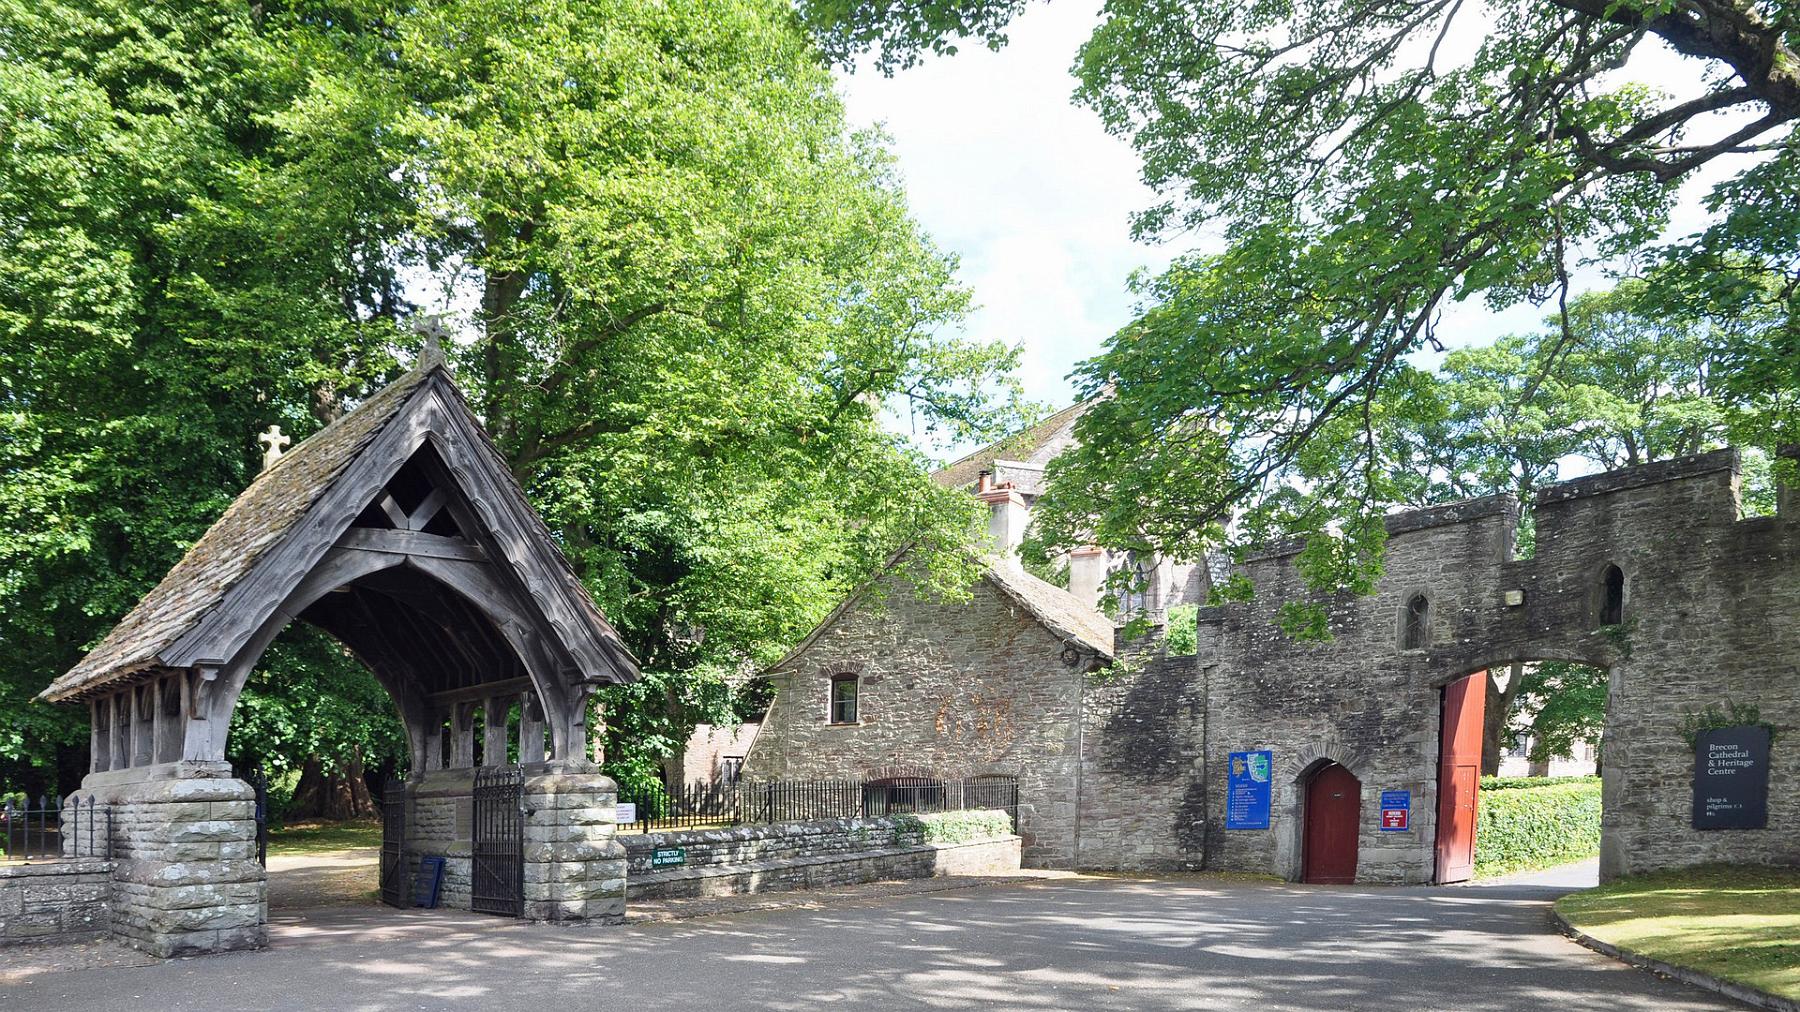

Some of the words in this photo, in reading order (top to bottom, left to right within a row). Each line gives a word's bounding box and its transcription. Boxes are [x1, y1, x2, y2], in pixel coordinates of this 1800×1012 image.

[1708, 750, 1748, 758] Cathedral
[1708, 759, 1715, 767] &
[1718, 760, 1754, 768] Heritage
[662, 856, 683, 864] PARKING
